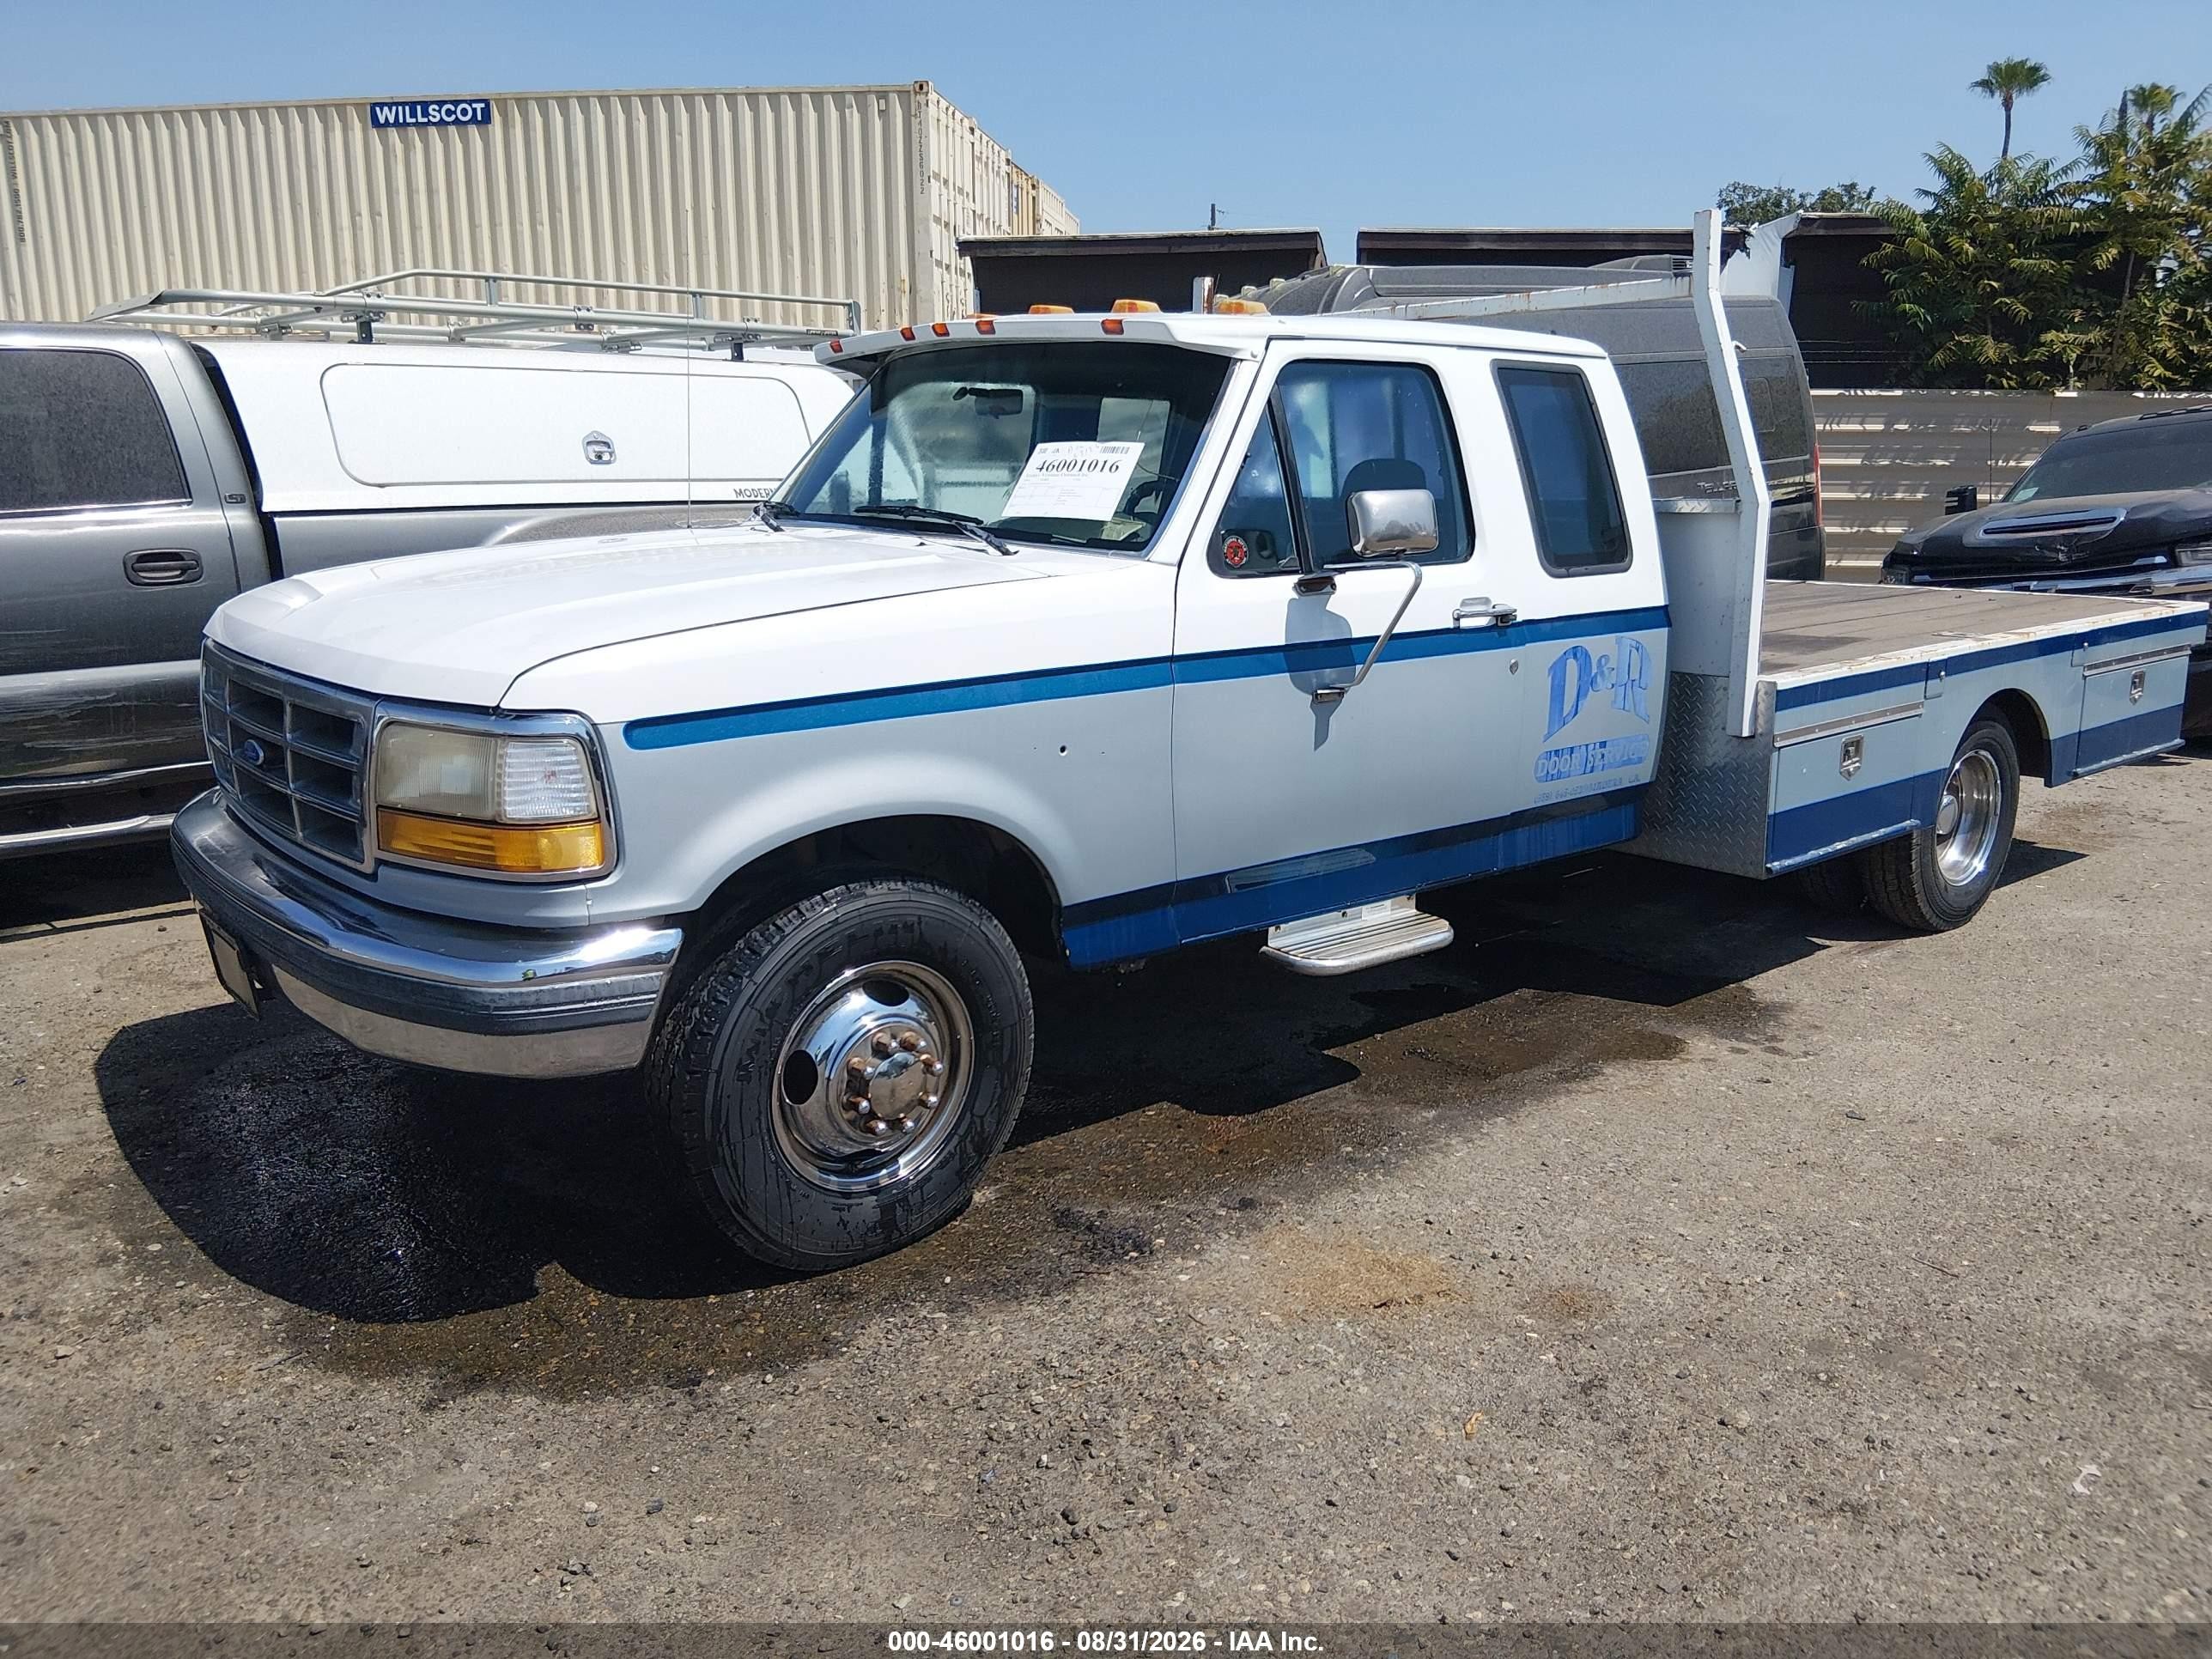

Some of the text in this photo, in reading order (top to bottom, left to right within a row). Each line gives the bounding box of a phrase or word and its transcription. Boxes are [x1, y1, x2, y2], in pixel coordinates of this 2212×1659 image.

[375, 103, 485, 125] WILLSCOT
[1036, 459, 1123, 473] 46001016
[1543, 635, 1651, 743] D&R
[1535, 753, 1582, 776] DOOR
